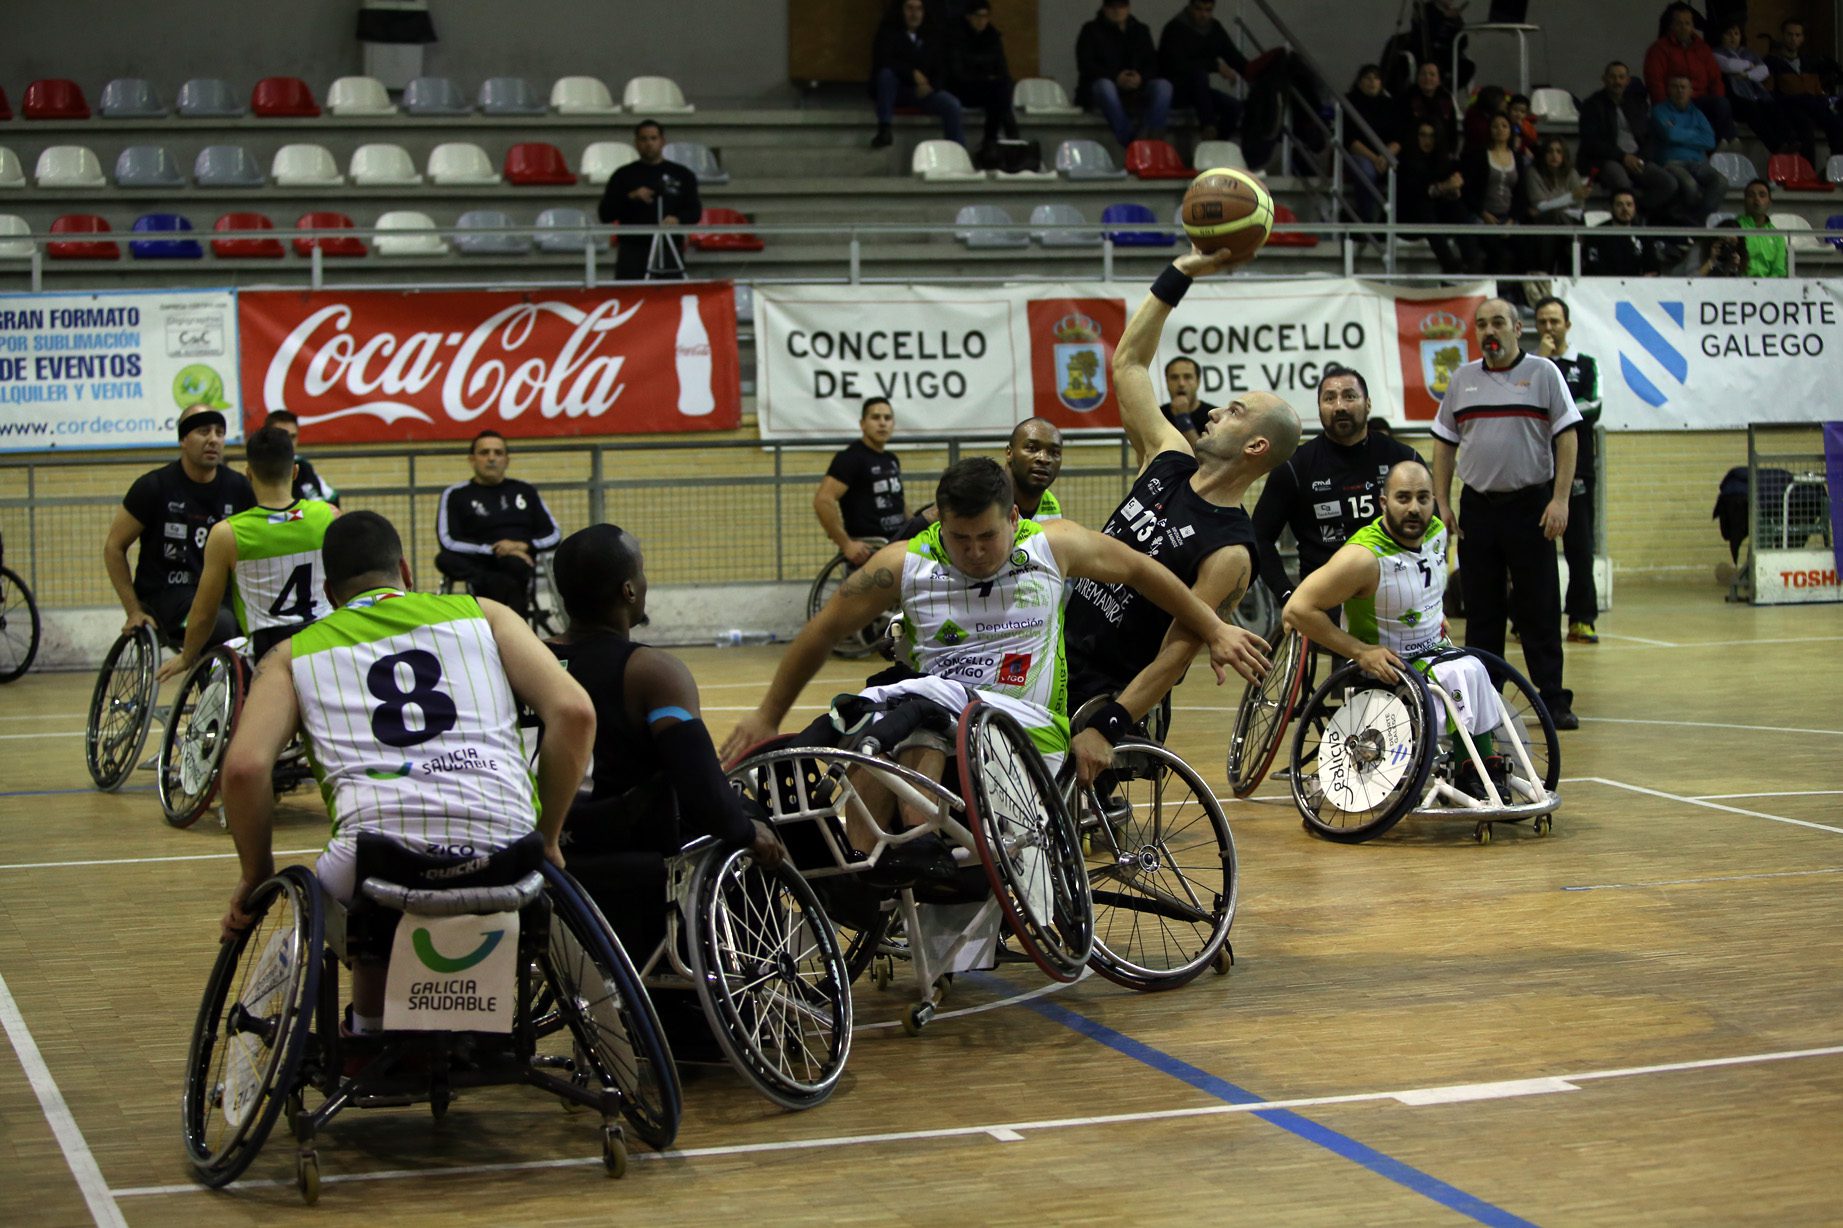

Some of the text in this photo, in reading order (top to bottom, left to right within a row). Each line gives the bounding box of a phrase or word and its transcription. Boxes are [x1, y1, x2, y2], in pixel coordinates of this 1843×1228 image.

[0, 309, 43, 330] RAN
[50, 307, 140, 328] FORMATO
[1700, 301, 1836, 325] DEPORTE
[0, 330, 140, 352] POR SUBLIMACIÓN
[787, 330, 987, 361] CONCELLO
[1177, 322, 1365, 354] CONCELLO
[1701, 333, 1824, 357] GALEGO
[0, 353, 142, 382] DE EVENTOS
[263, 297, 645, 425] Coca-Cola
[813, 371, 967, 399] DE VIGO
[1203, 364, 1250, 392] DE
[0, 381, 143, 404] LQUILER Y VENTA
[514, 493, 528, 510] 6
[1347, 494, 1375, 519] 15
[194, 526, 208, 549] 8
[1130, 509, 1158, 542] 13
[1780, 569, 1841, 589] TOSH
[269, 562, 318, 623] 4
[975, 617, 1044, 633] Deputación
[366, 648, 457, 748] 8
[1328, 731, 1354, 805] galicia
[410, 979, 477, 995] GALICIA
[408, 995, 497, 1012] SAUDABLE
